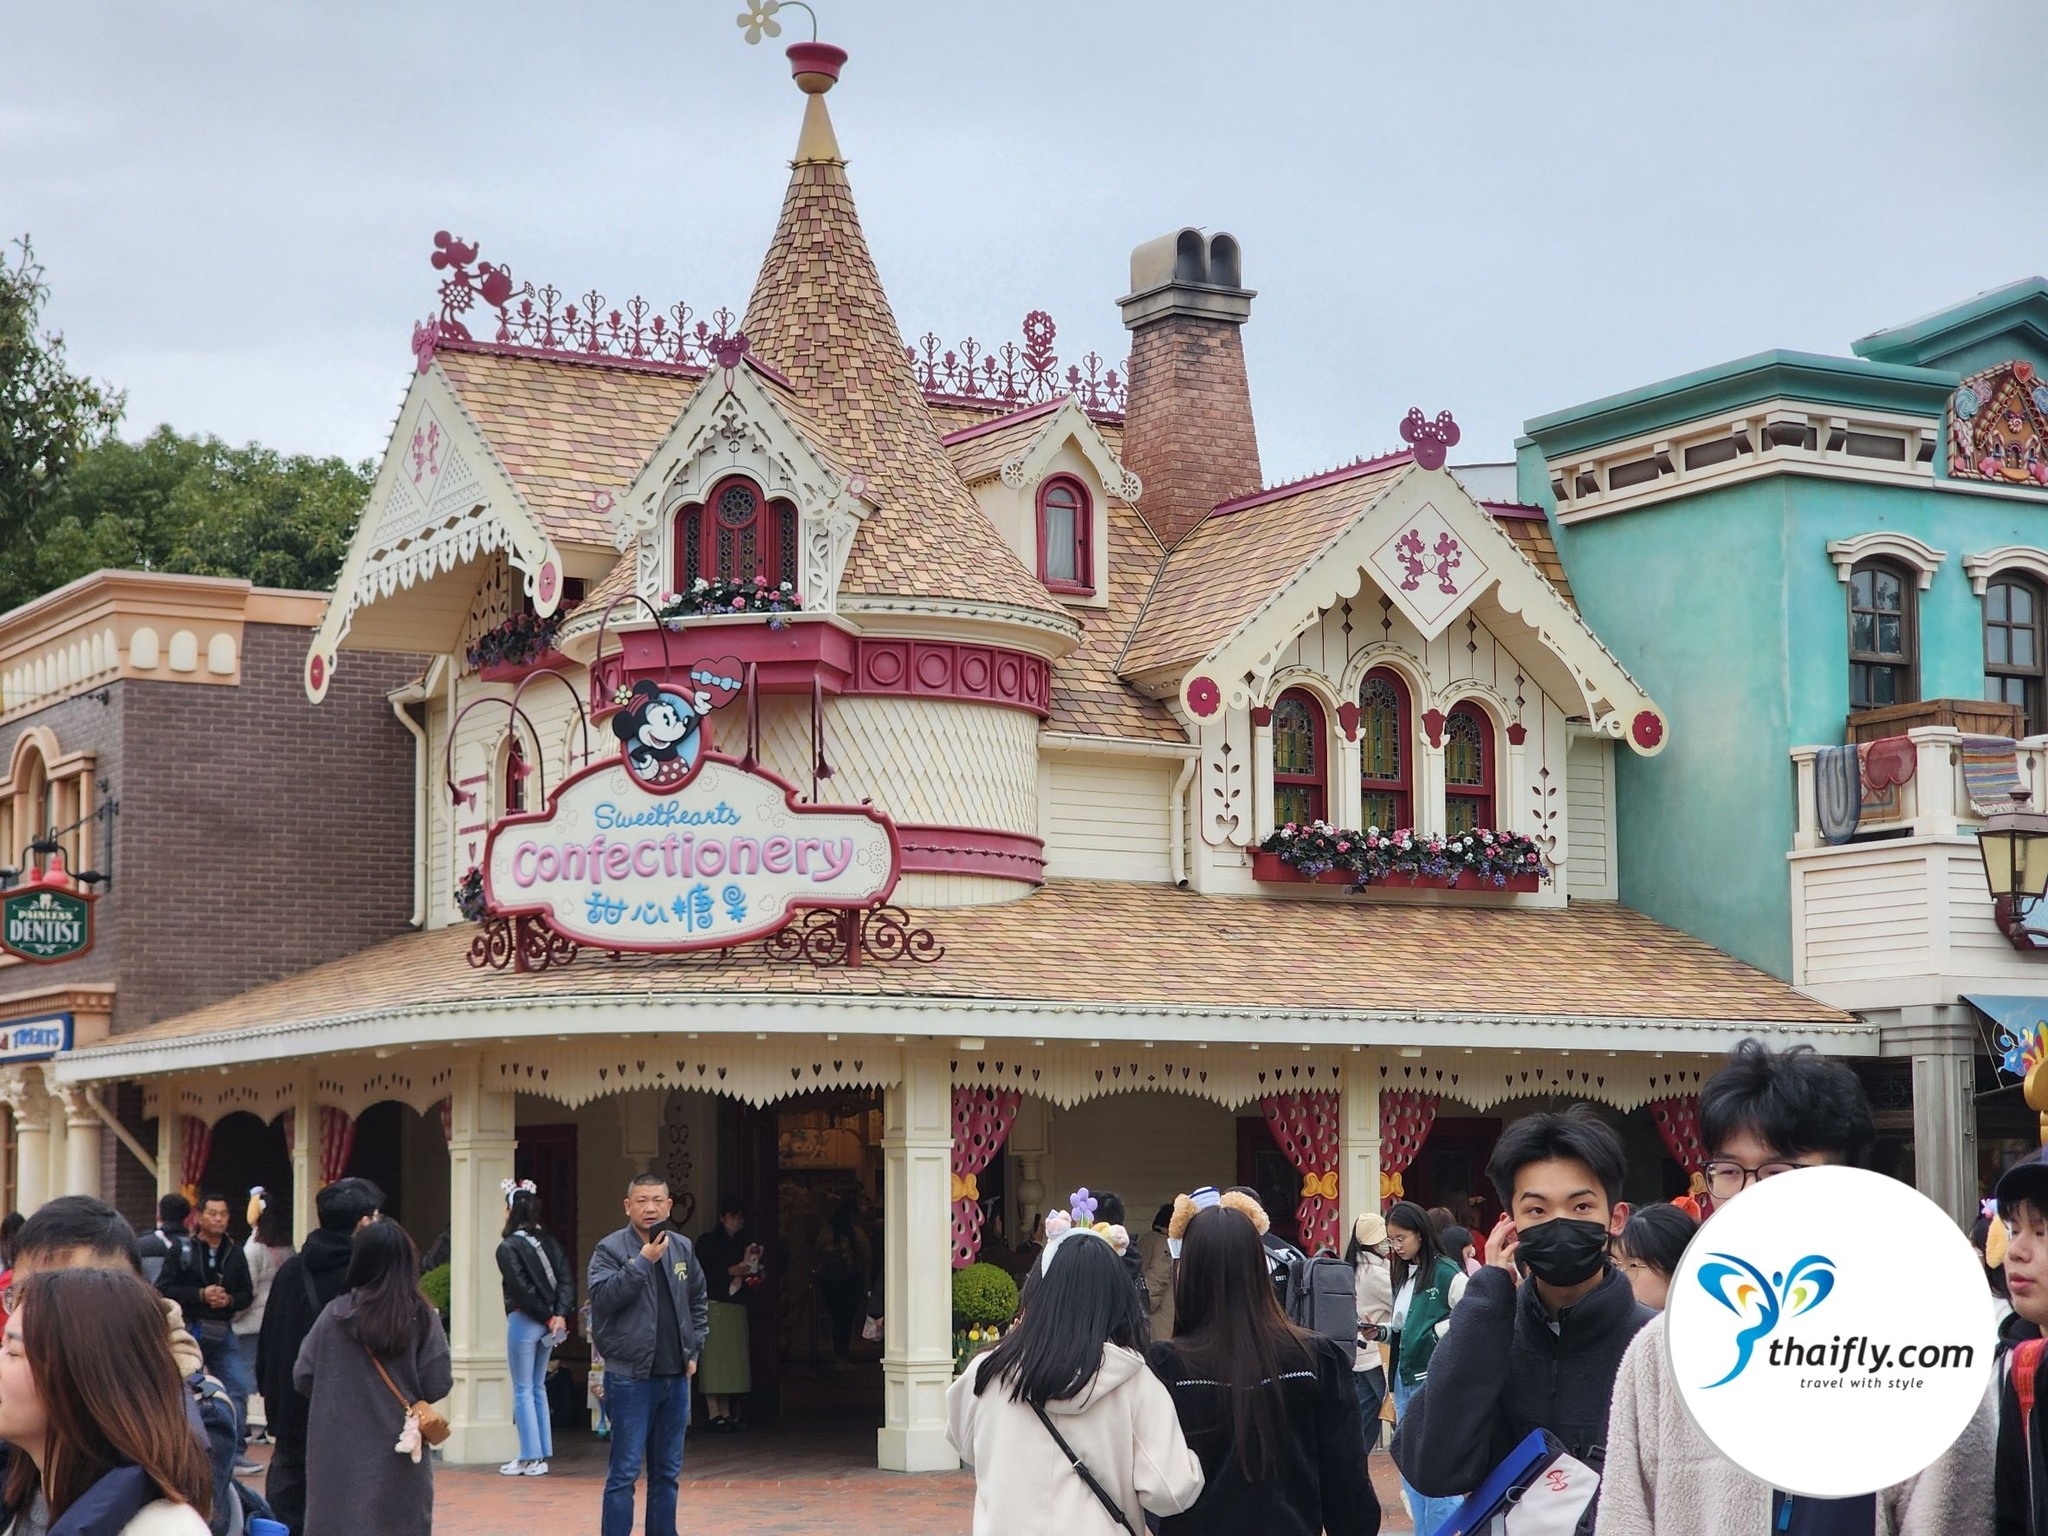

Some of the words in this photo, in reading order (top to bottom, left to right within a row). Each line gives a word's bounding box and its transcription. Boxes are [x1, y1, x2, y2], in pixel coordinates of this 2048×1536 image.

[594, 800, 742, 830] Sweethearts
[512, 832, 853, 888] Confectionery
[18, 910, 74, 921] PAINLESS
[584, 883, 748, 933] 甜心糖果
[10, 919, 82, 943] DENTIST
